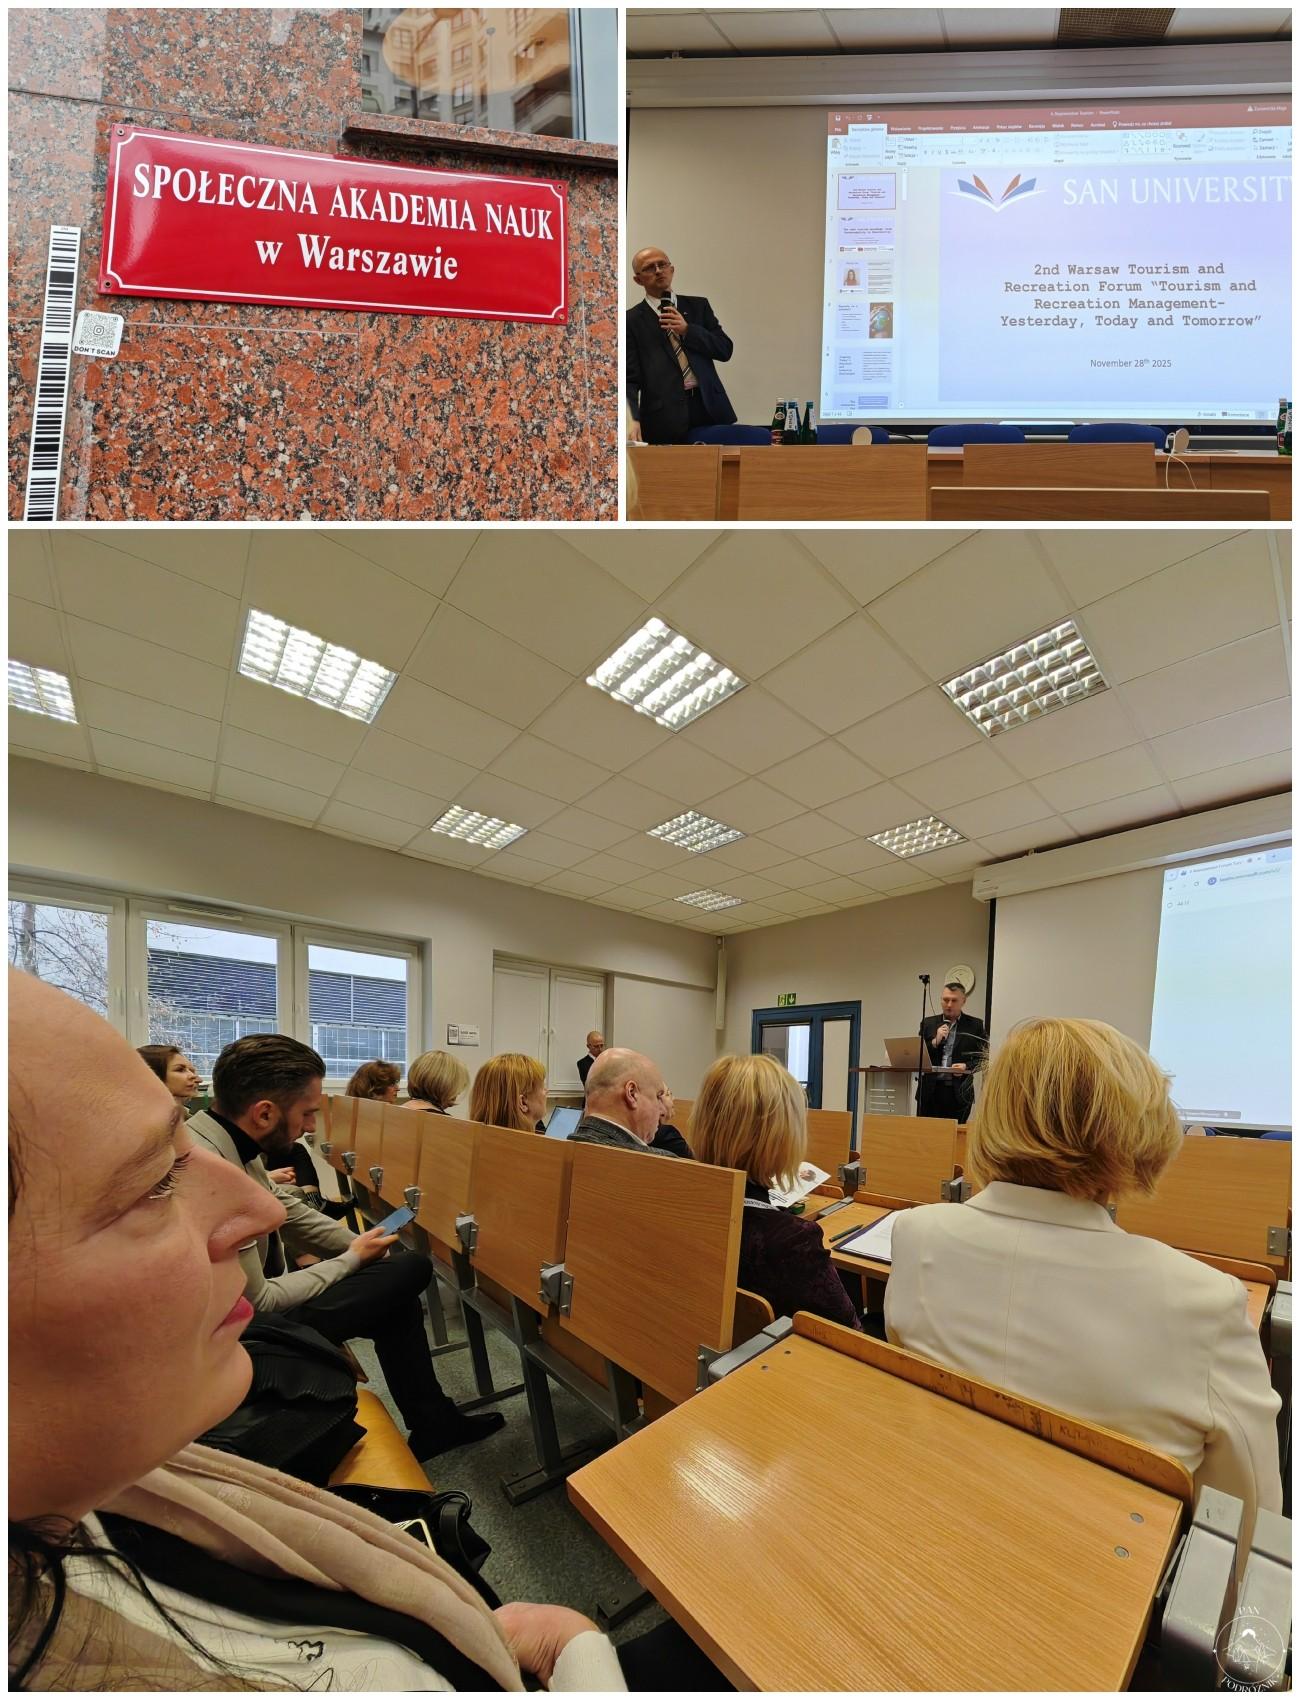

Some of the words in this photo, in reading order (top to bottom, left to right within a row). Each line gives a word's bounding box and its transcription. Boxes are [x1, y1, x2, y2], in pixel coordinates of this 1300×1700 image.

[1063, 178, 1118, 206] SAN
[1131, 175, 1292, 205] UNIVERSIT
[133, 163, 318, 215] SPOŁECZNA
[329, 184, 477, 231] AKADEMIA
[485, 203, 554, 240] NAUK
[255, 240, 283, 265] w
[297, 233, 458, 280] Warszawie
[1034, 263, 1060, 275] 2nd
[1068, 264, 1119, 275] Warsaw
[1128, 263, 1190, 275] Tourism
[1198, 263, 1225, 275] and
[1004, 280, 1090, 293] Recreation
[1099, 280, 1142, 293] Forum
[1229, 279, 1256, 292] and
[1034, 298, 1121, 310] Recreation
[1128, 298, 1225, 312] Management-
[1000, 315, 1086, 329] Yesterday,
[1095, 315, 1139, 329] Today
[1147, 314, 1174, 327] and
[1090, 358, 1132, 369] November
[1152, 358, 1172, 369] 2025
